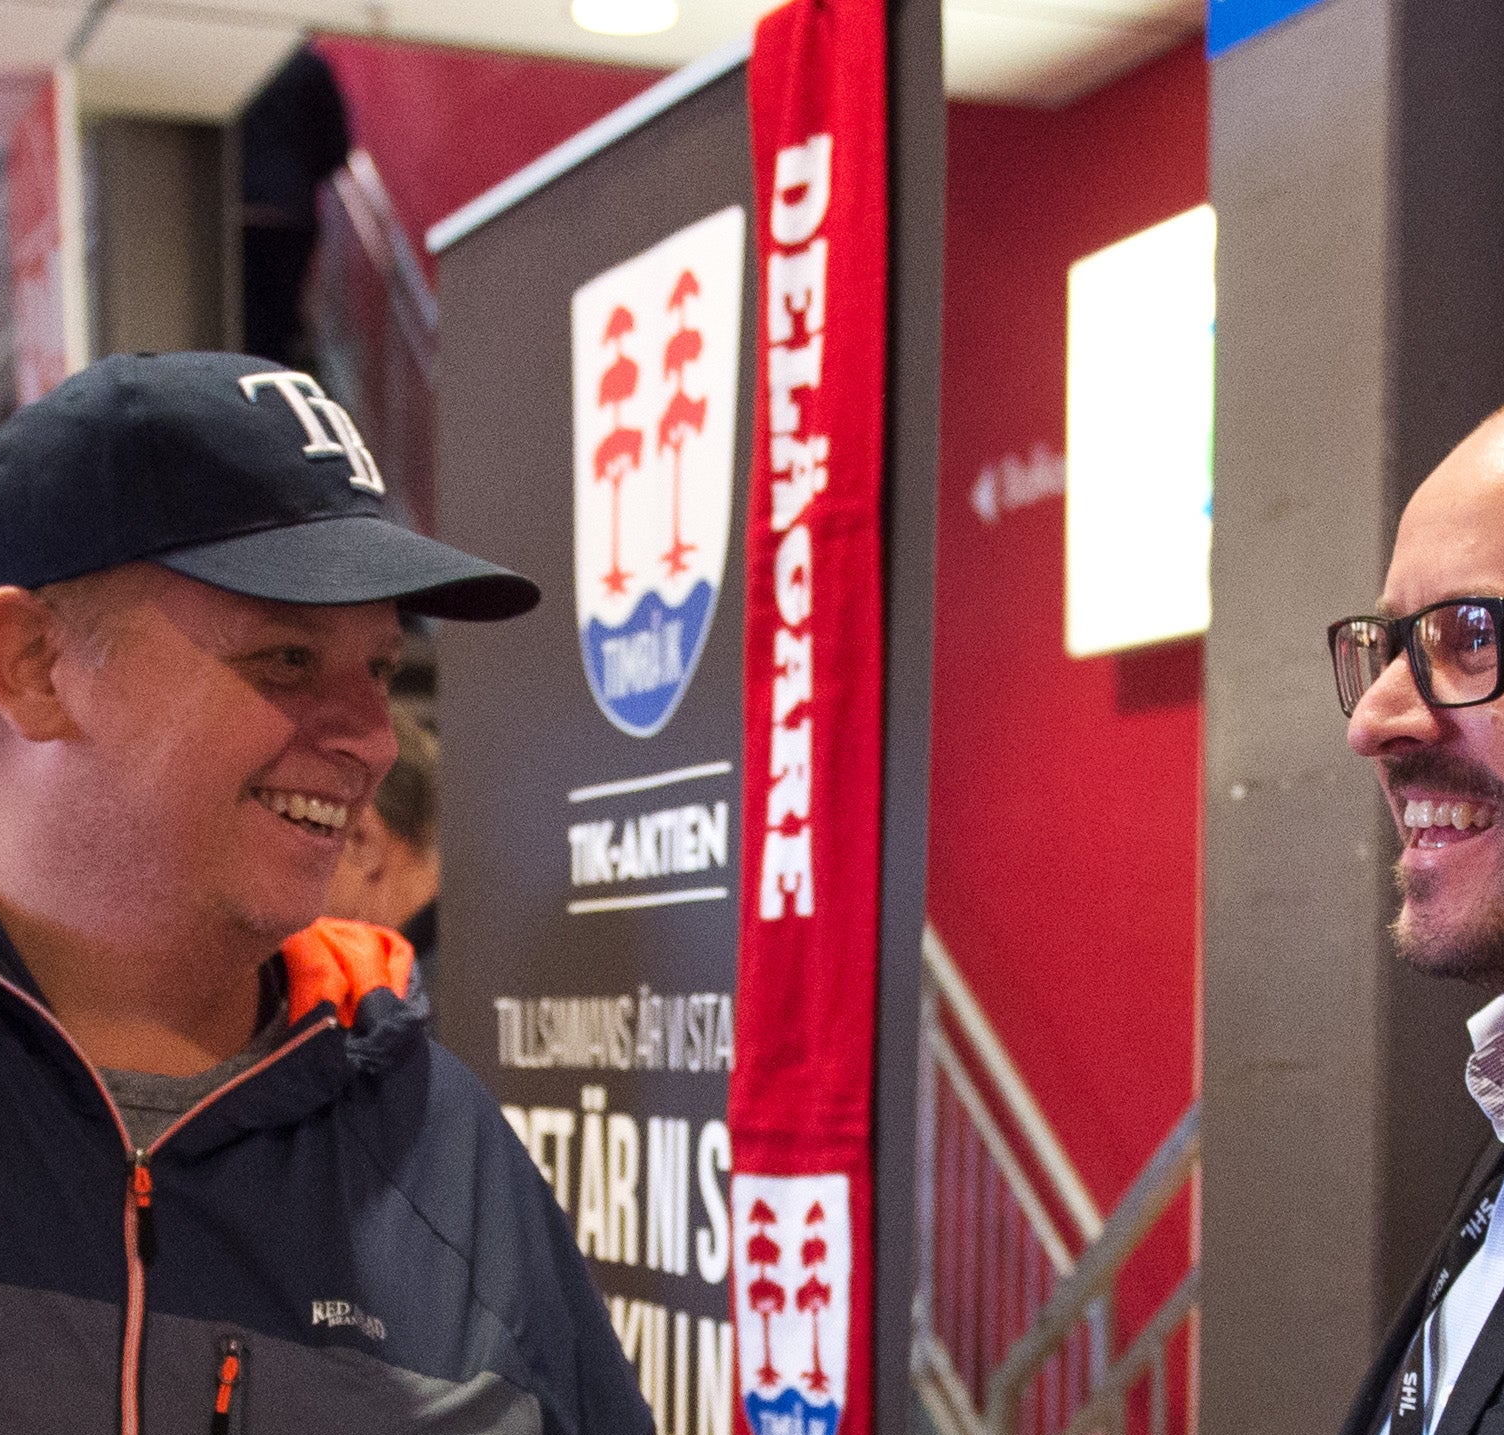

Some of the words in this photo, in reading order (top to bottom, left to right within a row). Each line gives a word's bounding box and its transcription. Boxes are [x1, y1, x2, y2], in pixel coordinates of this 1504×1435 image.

[500, 1105, 575, 1213] ET
[576, 1084, 639, 1266] ÄR
[647, 1115, 689, 1276] NI
